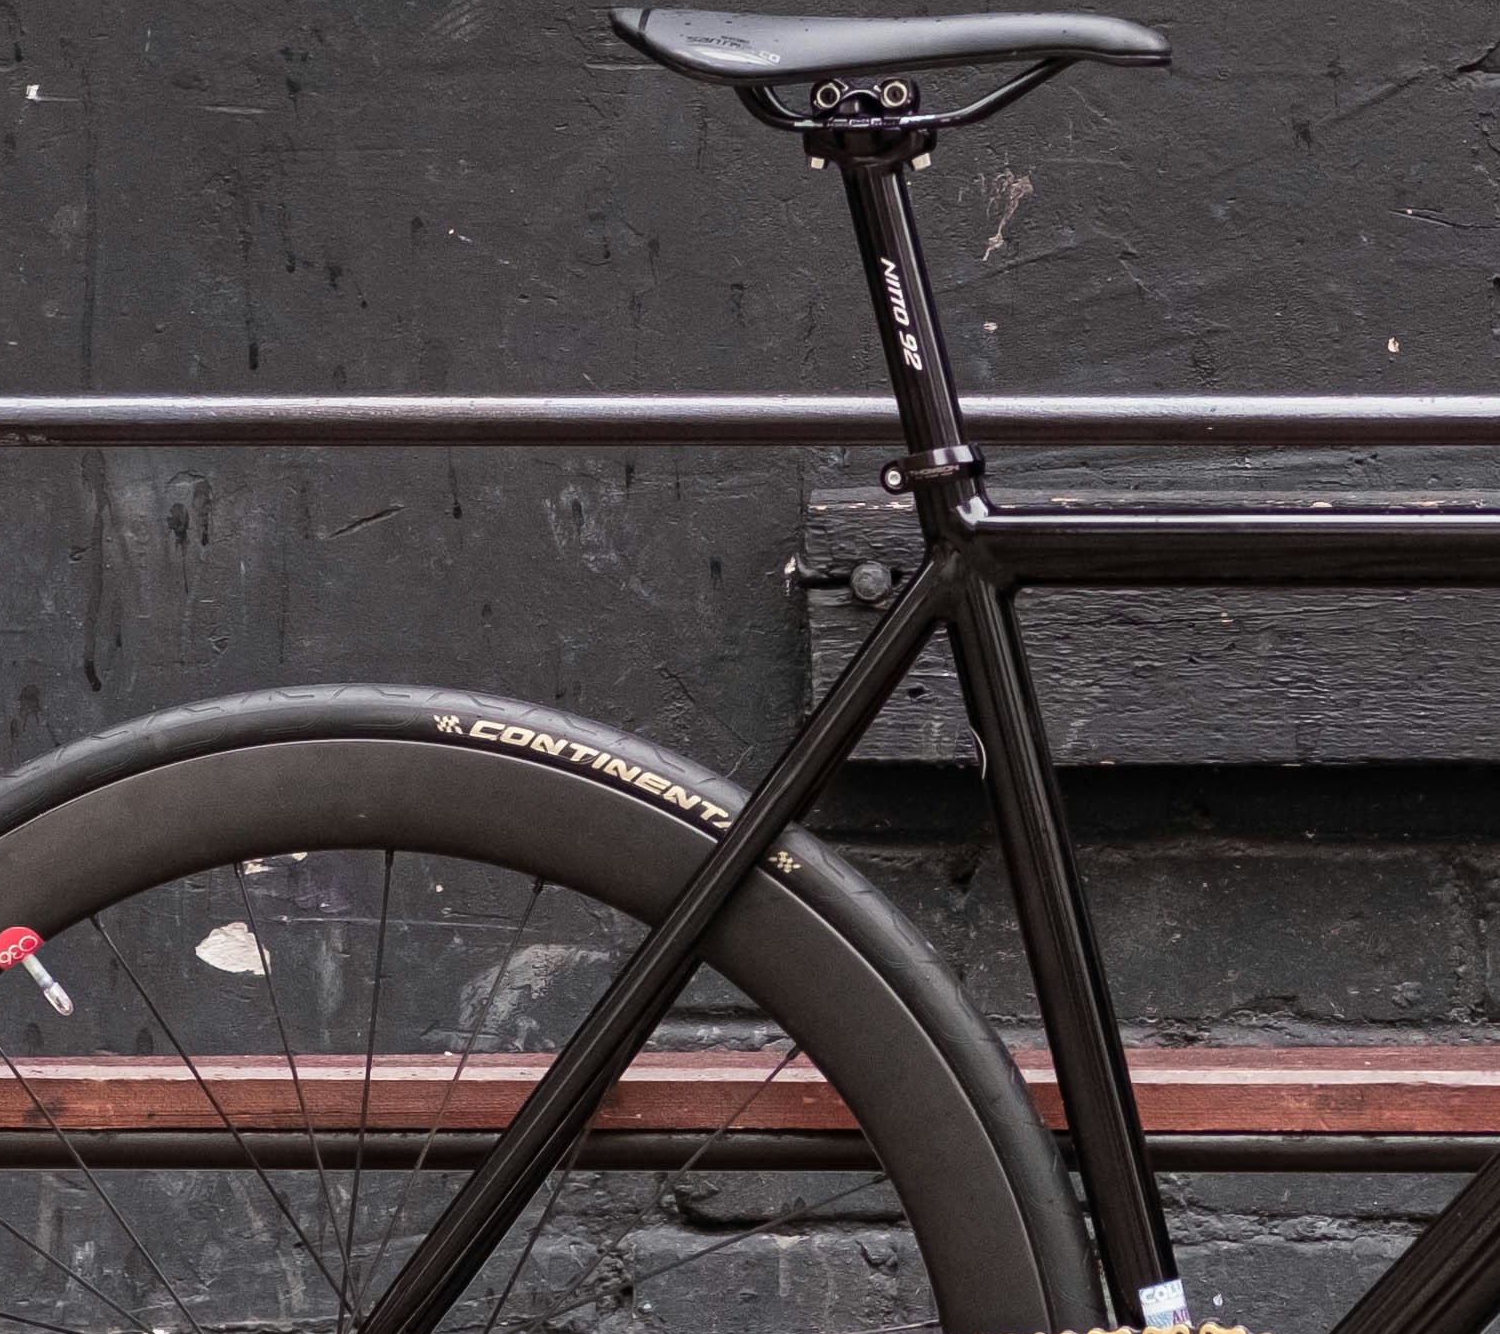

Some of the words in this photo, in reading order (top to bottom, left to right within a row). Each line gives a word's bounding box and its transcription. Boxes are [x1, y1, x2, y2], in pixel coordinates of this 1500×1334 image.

[880, 257, 910, 327] NITTO
[899, 330, 923, 371] 92
[469, 719, 734, 831] CONTINENT
